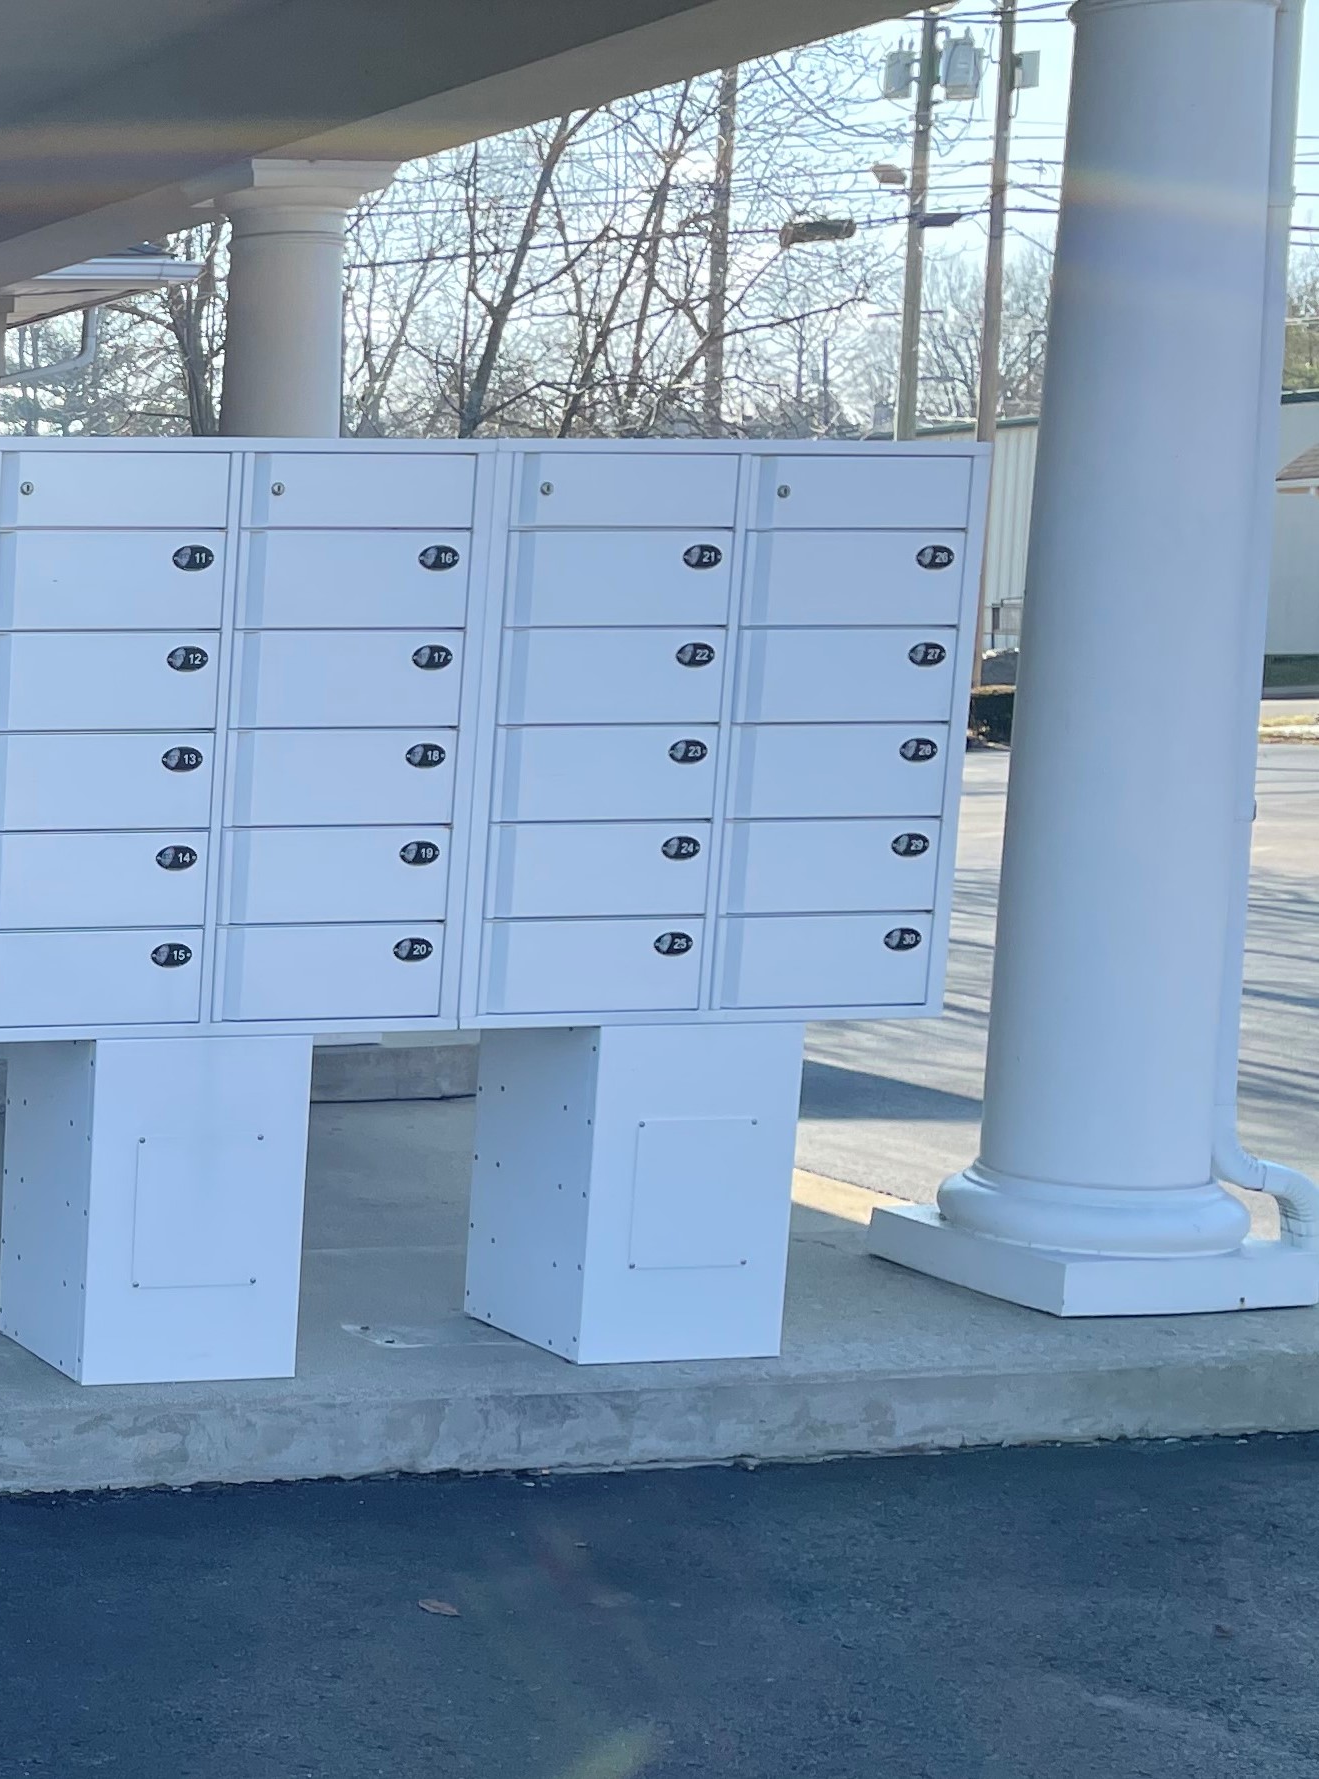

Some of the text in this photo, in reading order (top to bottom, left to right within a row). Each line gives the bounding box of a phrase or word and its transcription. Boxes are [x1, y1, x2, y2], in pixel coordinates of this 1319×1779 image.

[194, 552, 206, 563] 11
[440, 552, 453, 563] 16
[702, 551, 715, 563] 21
[189, 653, 202, 664] 12
[433, 652, 446, 663] 17
[695, 649, 709, 661] 22
[427, 750, 440, 761] 18
[688, 746, 702, 757] 23
[183, 754, 197, 765] 13
[421, 847, 434, 859] 19
[680, 842, 694, 854] 24
[177, 852, 191, 863] 14
[673, 938, 687, 949] 25
[902, 934, 916, 945] 30
[172, 949, 186, 960] 15
[413, 944, 427, 955] 20
